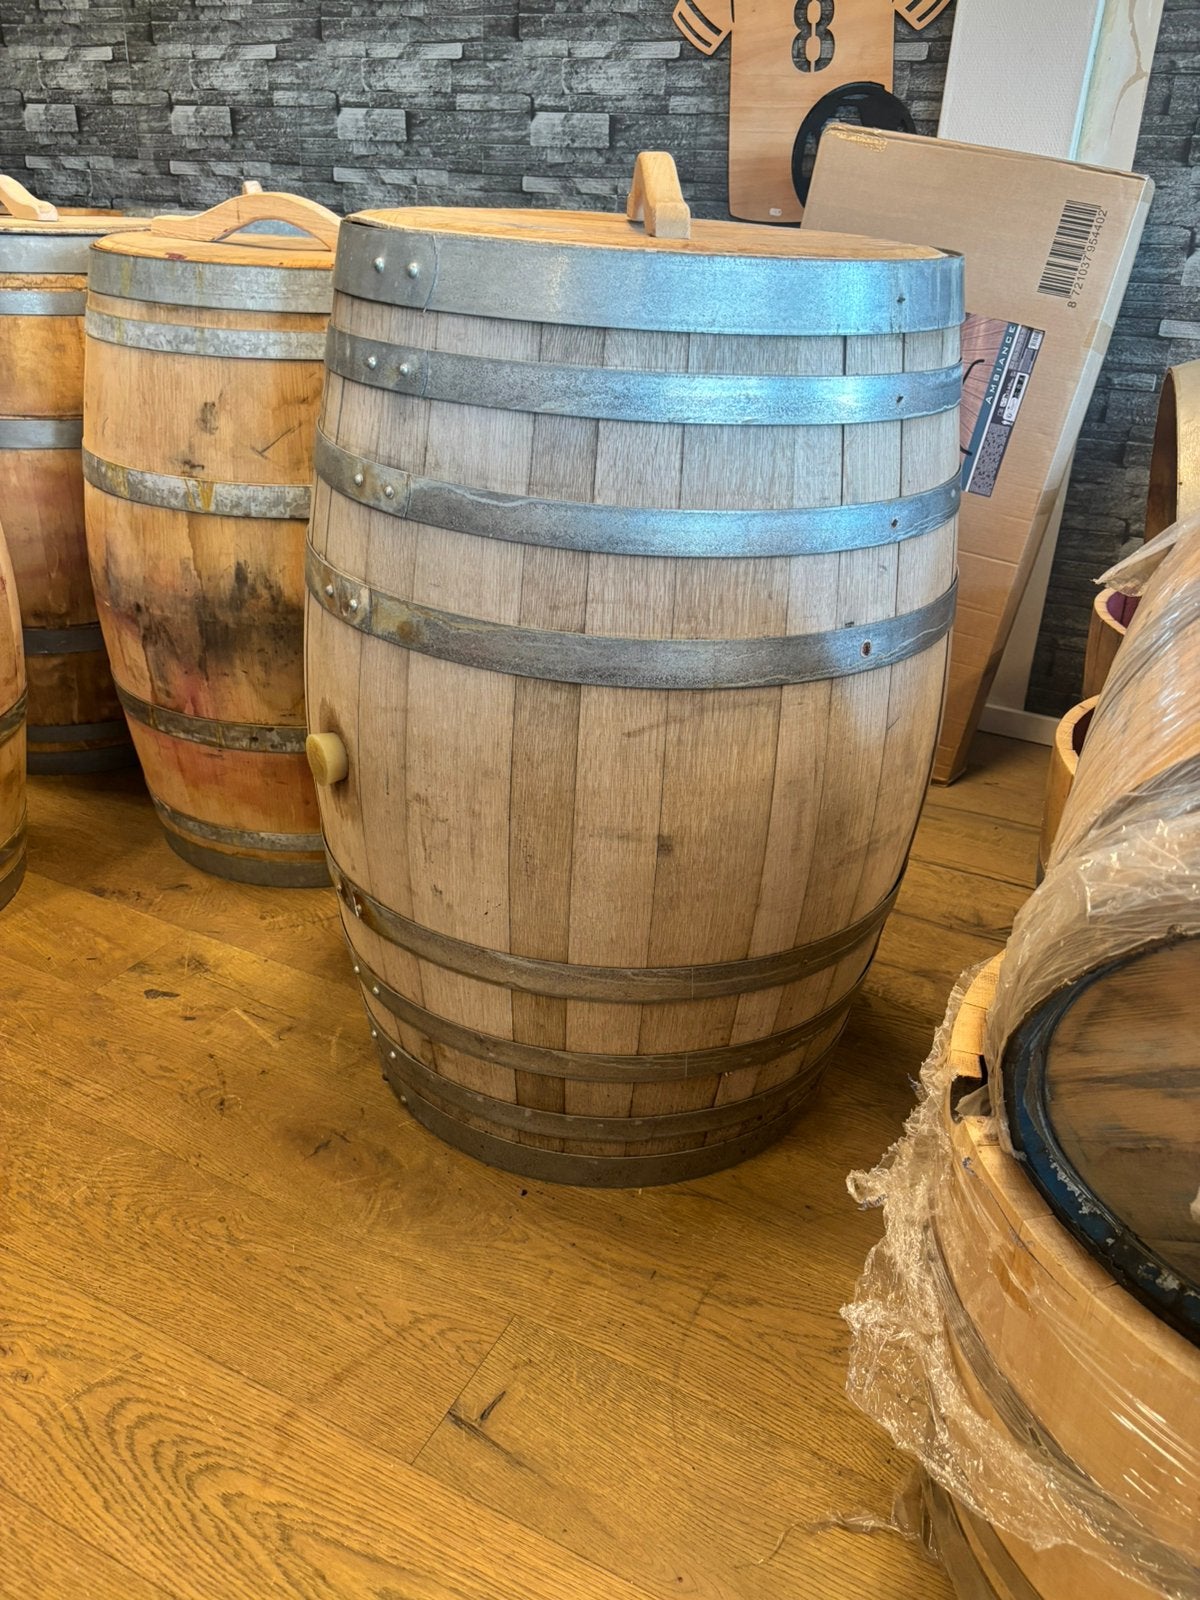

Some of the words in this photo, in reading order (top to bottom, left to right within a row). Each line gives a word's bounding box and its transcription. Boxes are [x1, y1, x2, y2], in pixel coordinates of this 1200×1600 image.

[792, 0, 835, 72] 8
[1086, 209, 1108, 252] 954402
[1071, 255, 1092, 296] 721037
[1067, 301, 1077, 309] 8
[985, 326, 1016, 404] AMBIANCE
